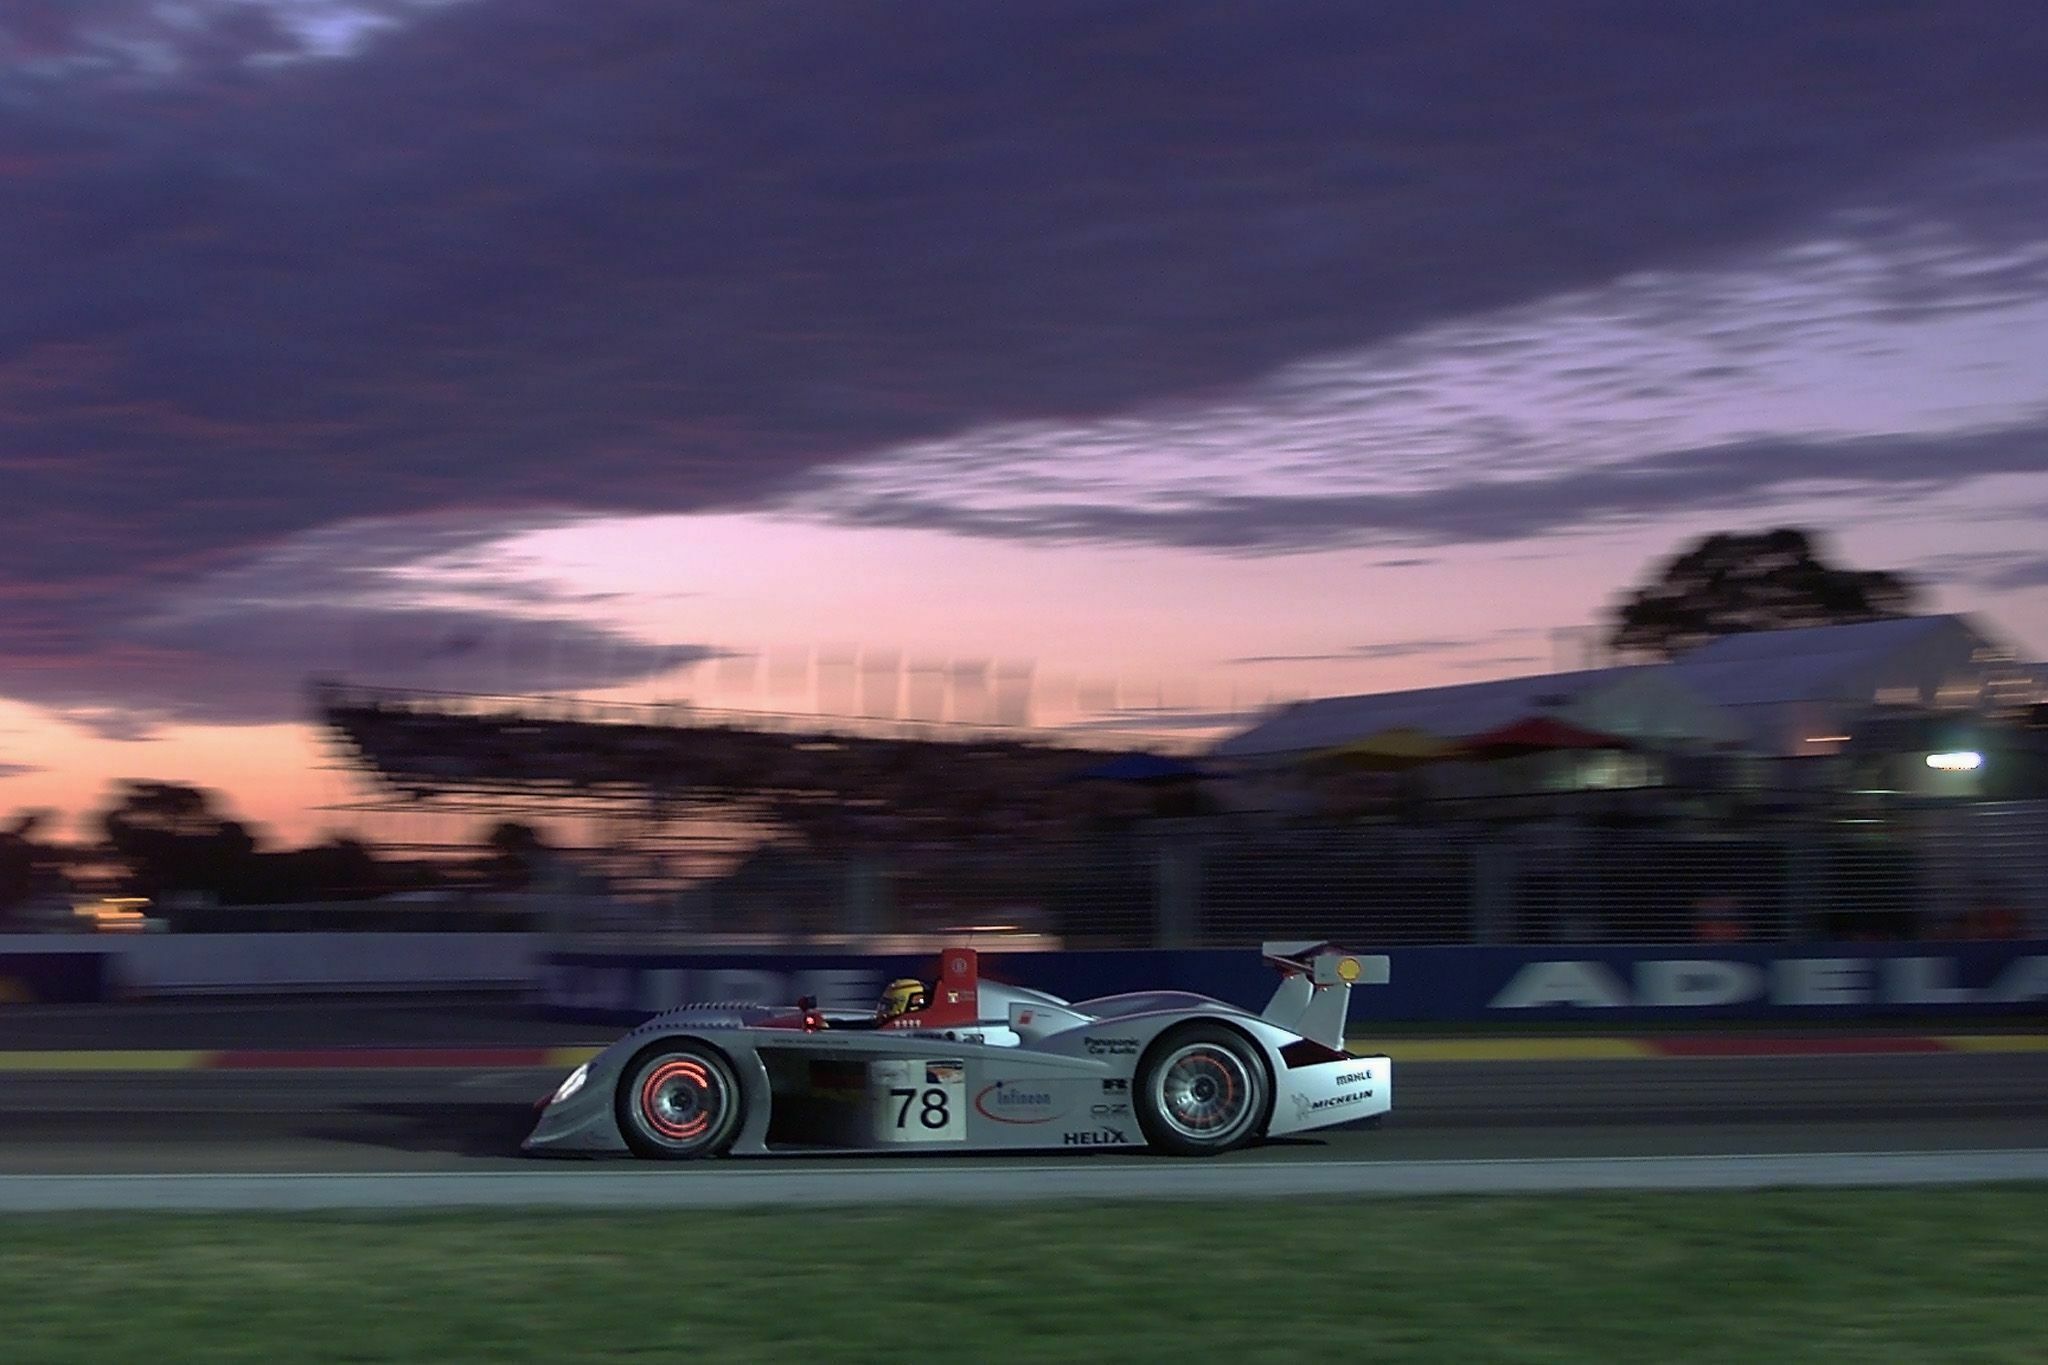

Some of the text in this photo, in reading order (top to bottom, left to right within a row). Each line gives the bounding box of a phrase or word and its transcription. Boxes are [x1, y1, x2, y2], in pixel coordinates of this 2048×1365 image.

[1085, 1037, 1140, 1046] Panasonic
[1336, 1070, 1372, 1085] MAHLE
[889, 1088, 950, 1129] 78
[1312, 1090, 1373, 1109] MICHELIN
[1063, 1126, 1129, 1145] HELIX
